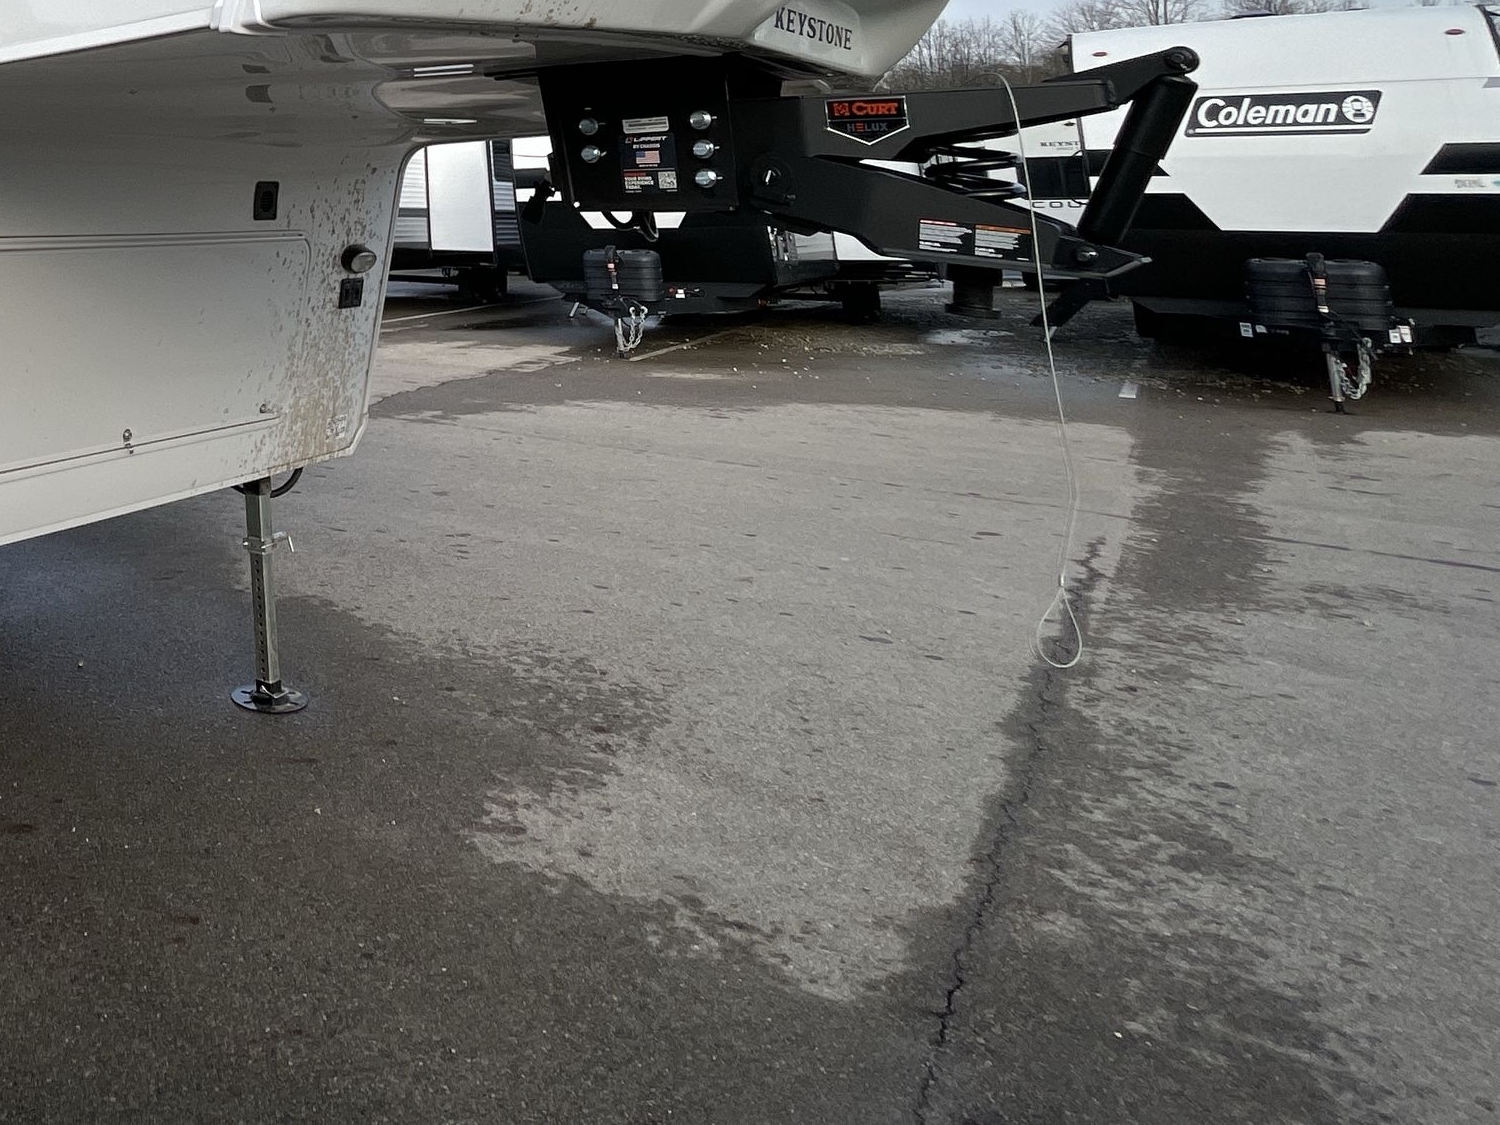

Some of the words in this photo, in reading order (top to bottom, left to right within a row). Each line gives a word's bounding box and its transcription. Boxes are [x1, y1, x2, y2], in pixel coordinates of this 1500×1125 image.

[774, 6, 853, 50] KEYSTONE
[851, 102, 898, 116] CURT
[1197, 97, 1339, 128] Coleman
[846, 122, 889, 133] HELUX
